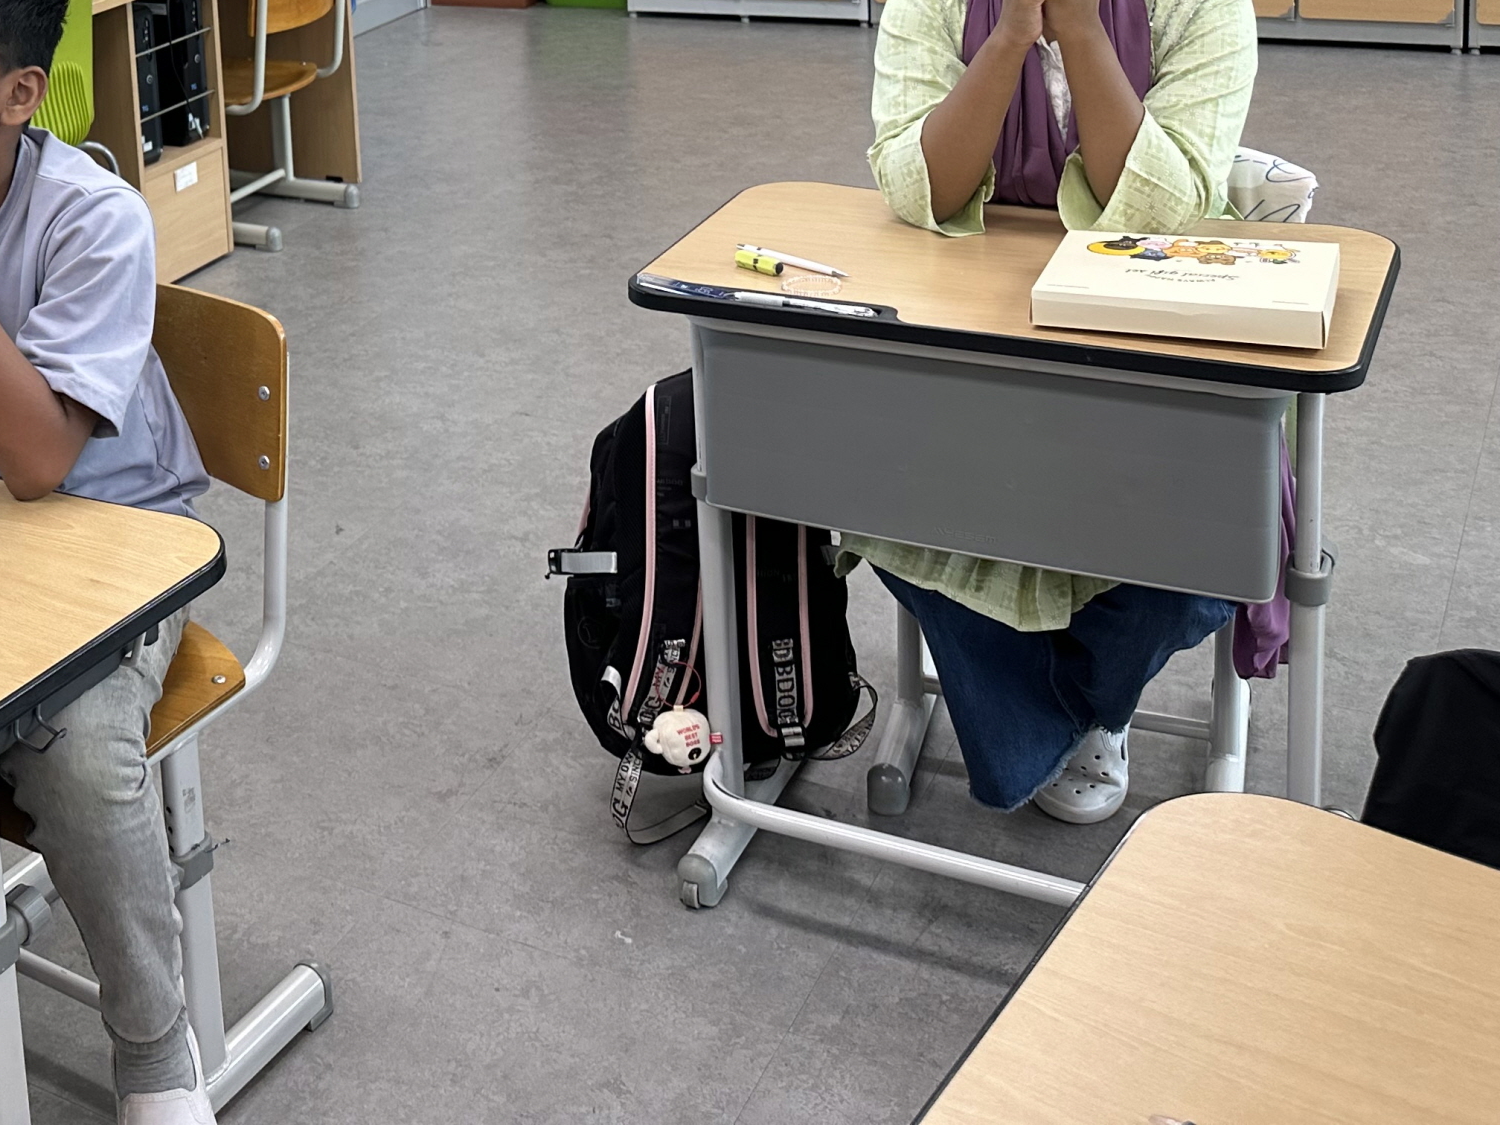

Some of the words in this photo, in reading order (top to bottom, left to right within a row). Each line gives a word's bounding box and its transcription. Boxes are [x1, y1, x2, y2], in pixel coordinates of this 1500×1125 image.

[684, 732, 698, 741] BEST
[616, 770, 628, 792] MY
[631, 758, 642, 783] SINC
